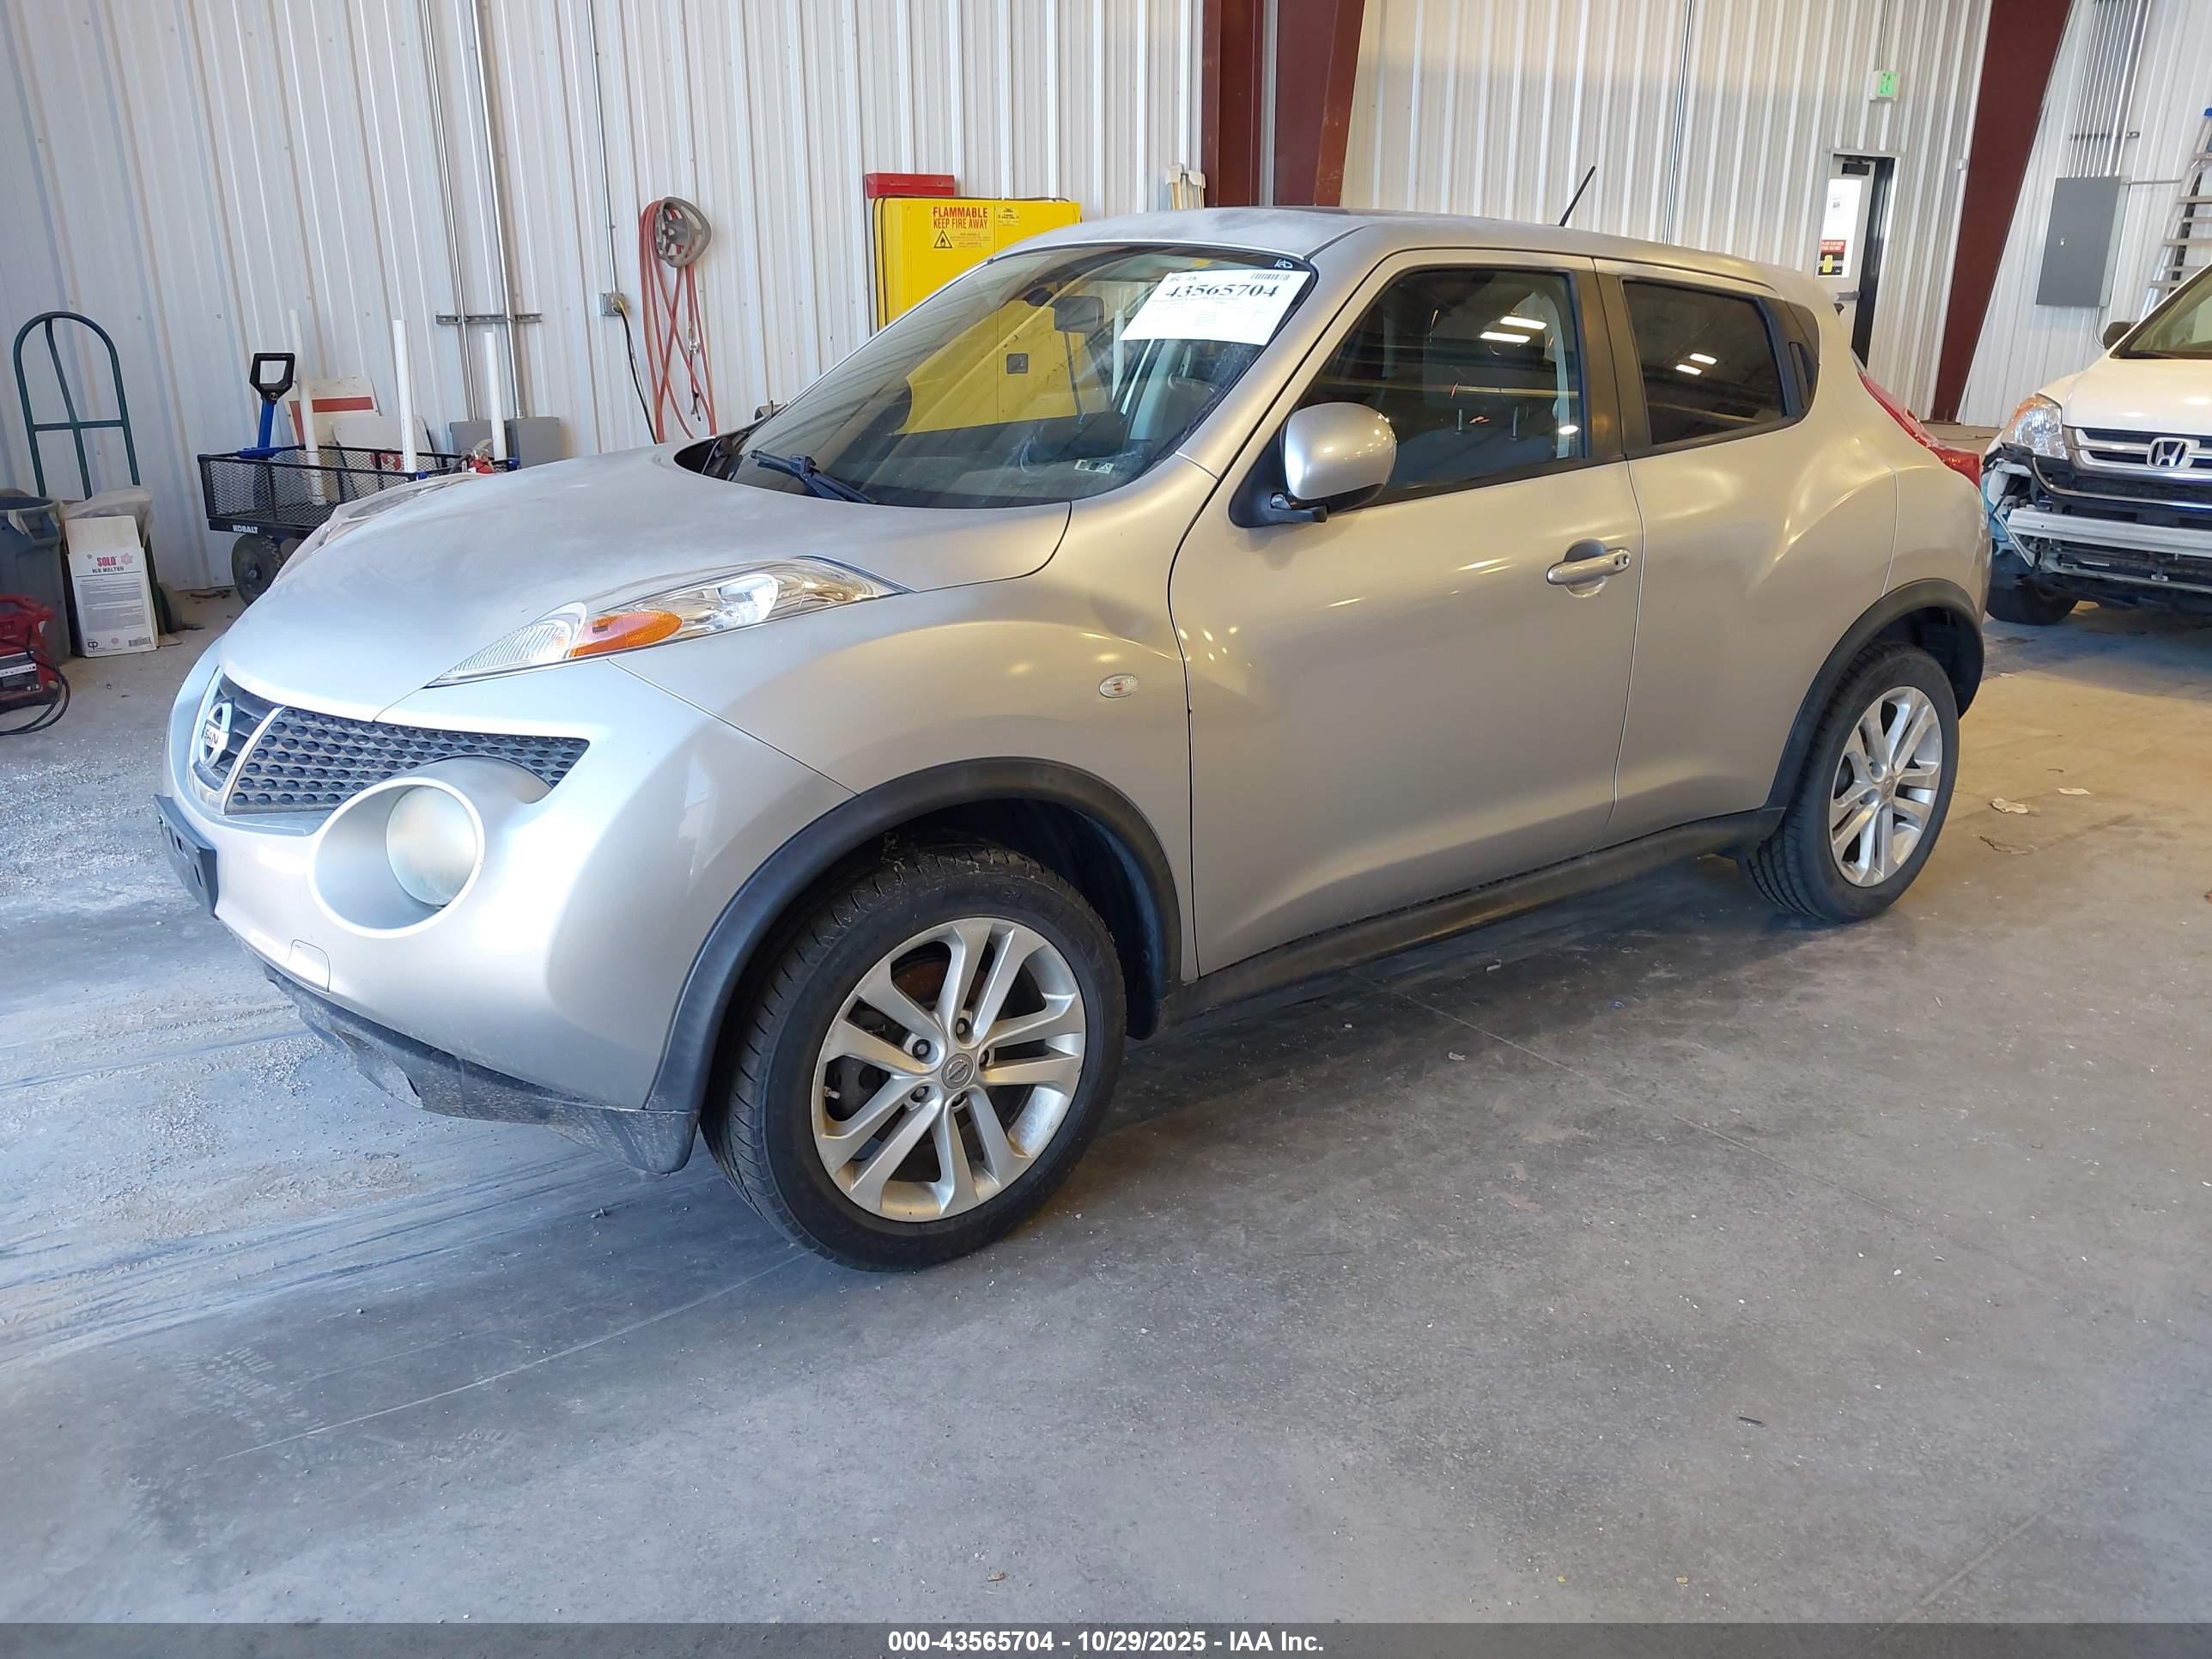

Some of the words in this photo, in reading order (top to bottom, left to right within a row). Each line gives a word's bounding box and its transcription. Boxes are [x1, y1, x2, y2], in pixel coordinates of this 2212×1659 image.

[933, 206, 988, 218] FLAMMABLE
[933, 218, 950, 229] KEEP
[951, 218, 967, 229] FIRE
[969, 218, 988, 229] AWAY
[1165, 283, 1280, 297] 43565704
[233, 525, 258, 533] KOBALT
[97, 556, 116, 567] SOLO
